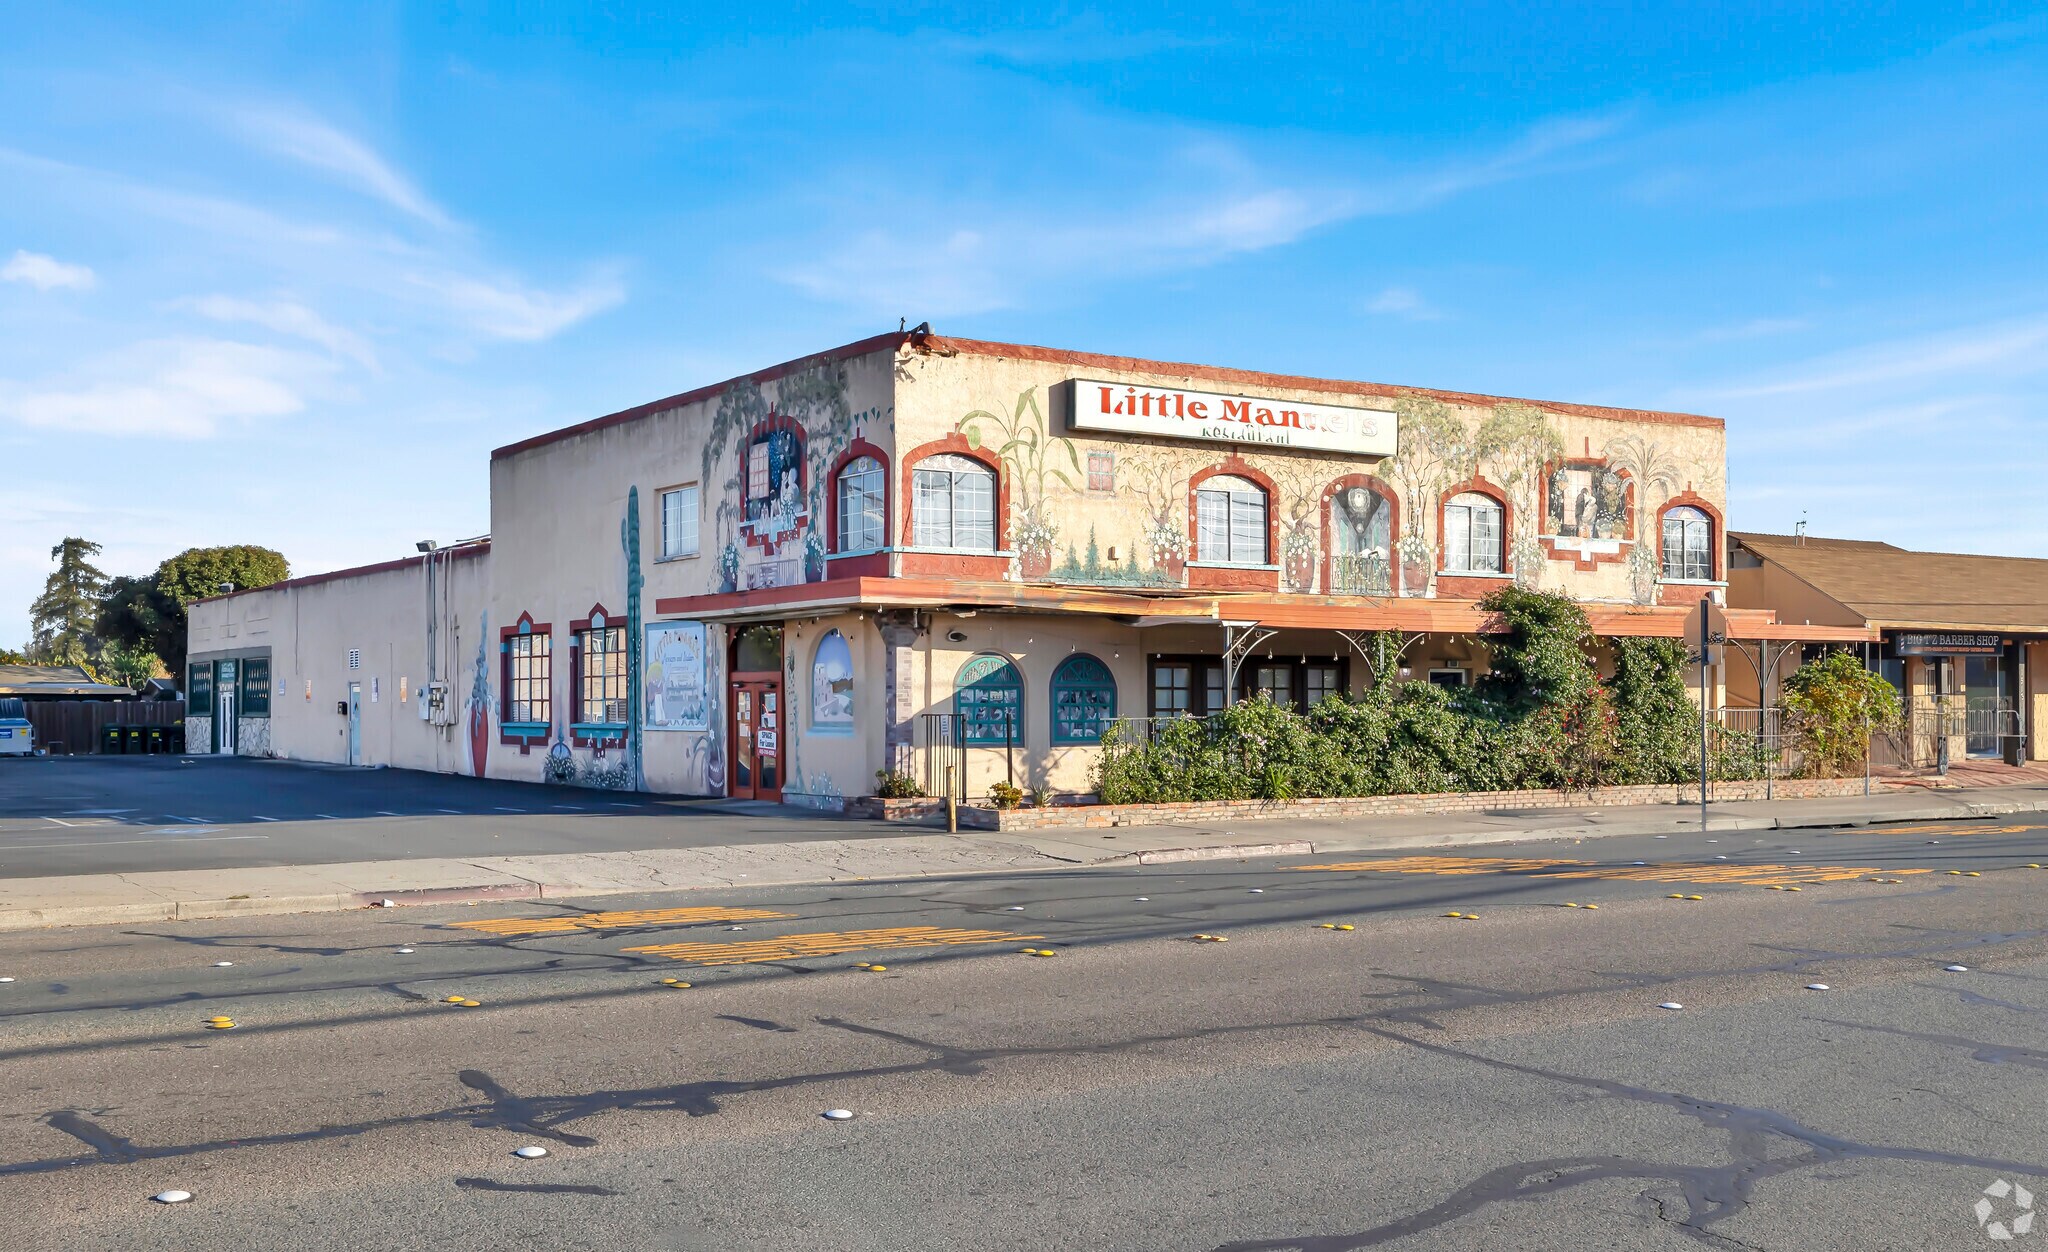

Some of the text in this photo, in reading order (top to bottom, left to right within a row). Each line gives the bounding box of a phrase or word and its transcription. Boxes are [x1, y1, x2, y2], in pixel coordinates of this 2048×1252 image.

[1097, 386, 1208, 421] Little
[1906, 634, 1923, 645] BIG
[1939, 634, 1976, 646] BARBER
[1976, 635, 1999, 646] SHOP
[761, 731, 773, 740] SPACE
